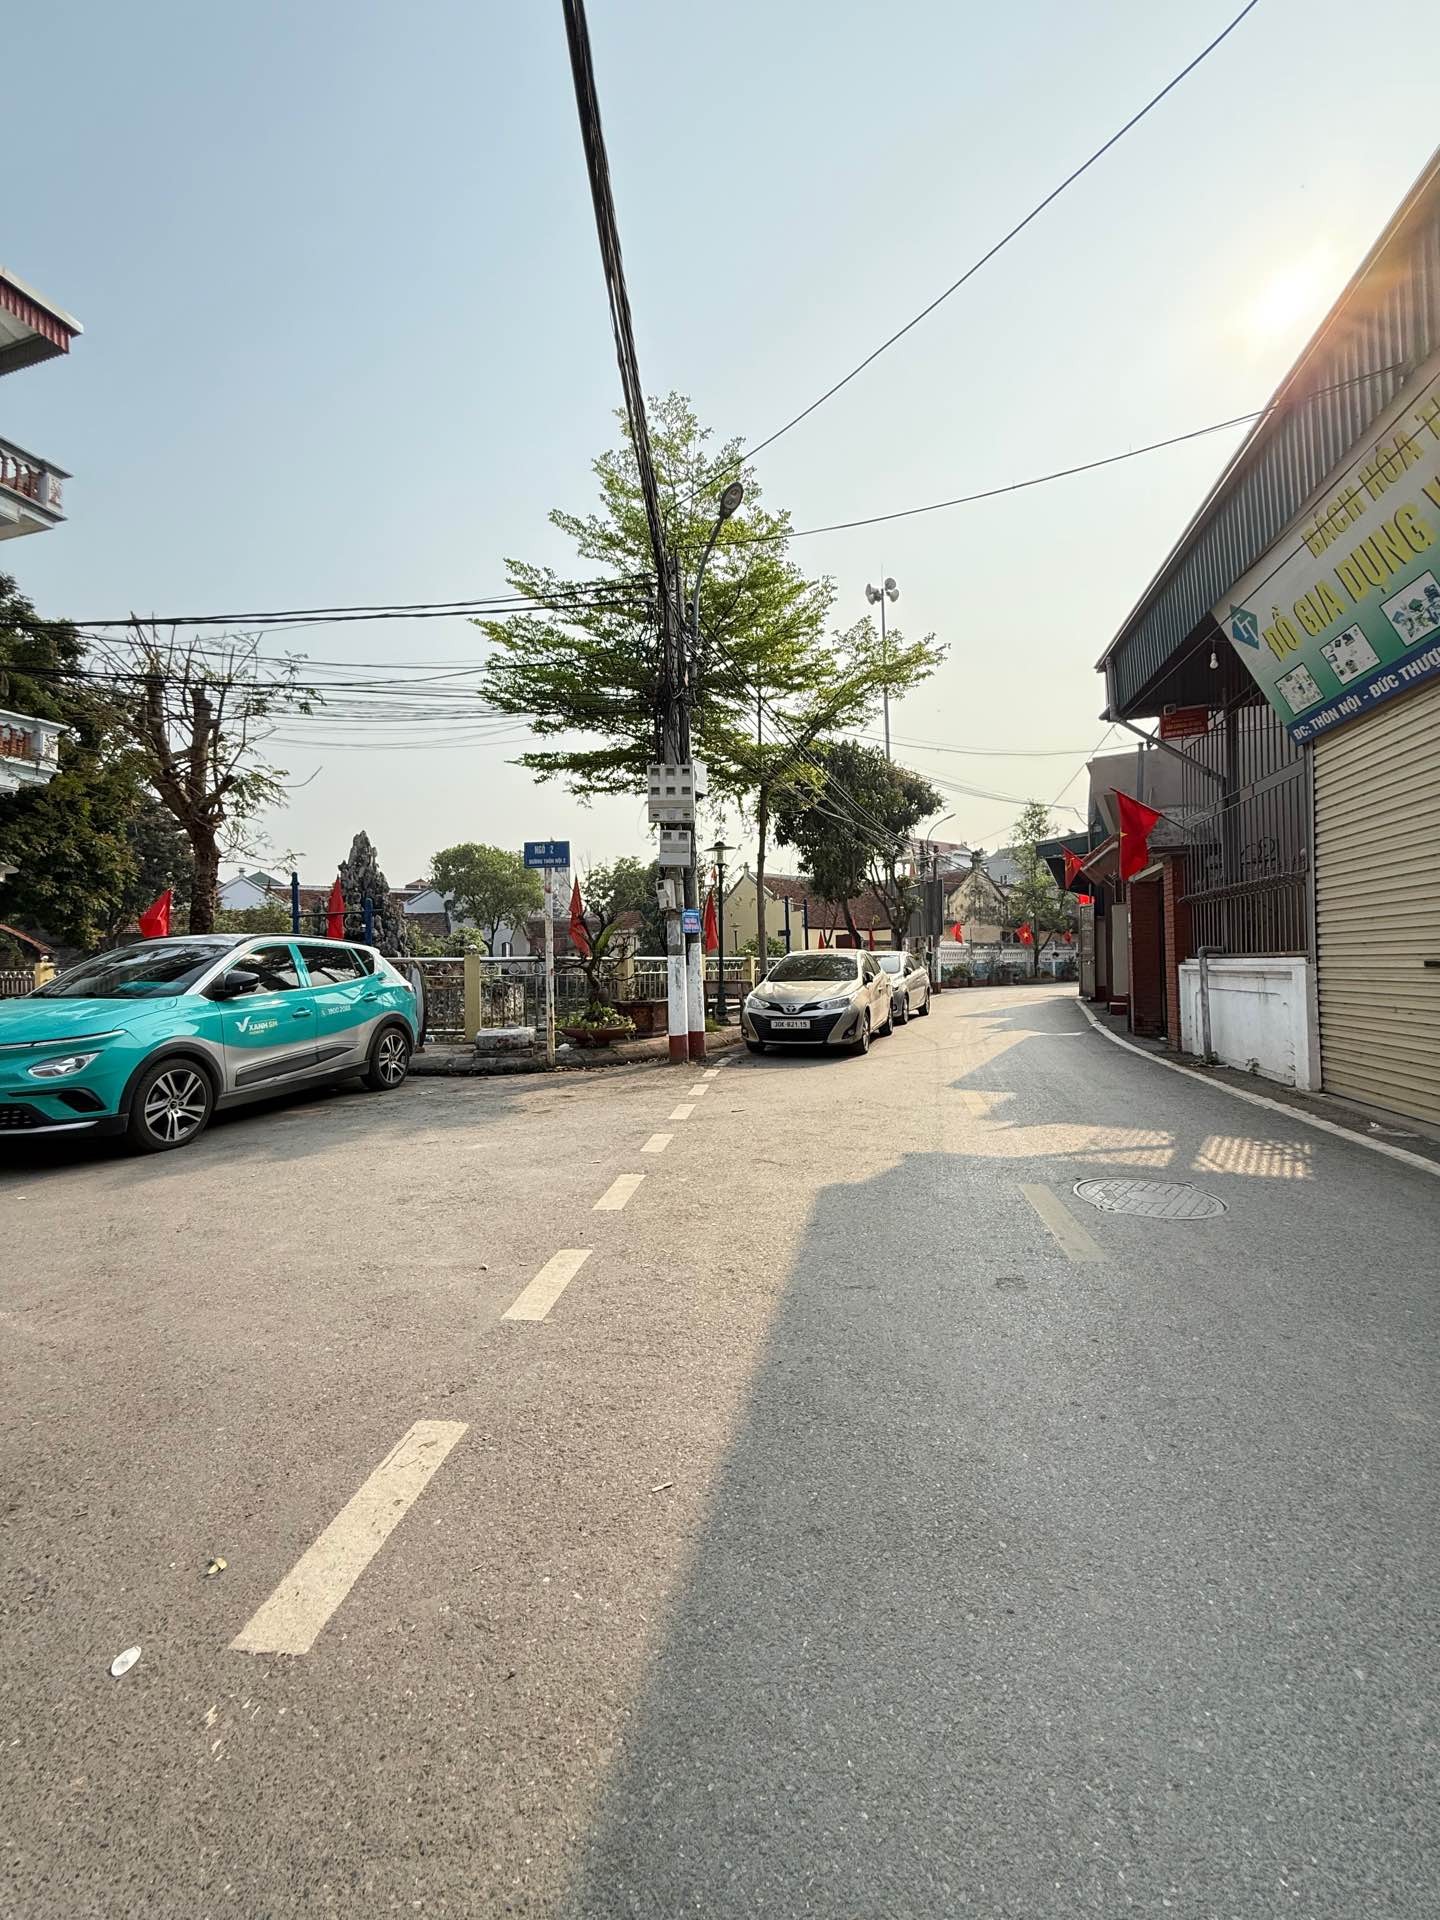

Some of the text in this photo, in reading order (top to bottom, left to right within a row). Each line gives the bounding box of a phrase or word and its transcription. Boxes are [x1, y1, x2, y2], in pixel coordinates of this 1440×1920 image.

[1301, 486, 1366, 559] BÁCH
[1358, 431, 1424, 502] HÓA
[1262, 503, 1436, 663] ĐỒ GIA DỤNG
[1309, 708, 1340, 730] THÔN
[1341, 694, 1362, 713] NỘI
[1368, 673, 1399, 698] ĐỨC
[249, 1022, 269, 1031] XANH
